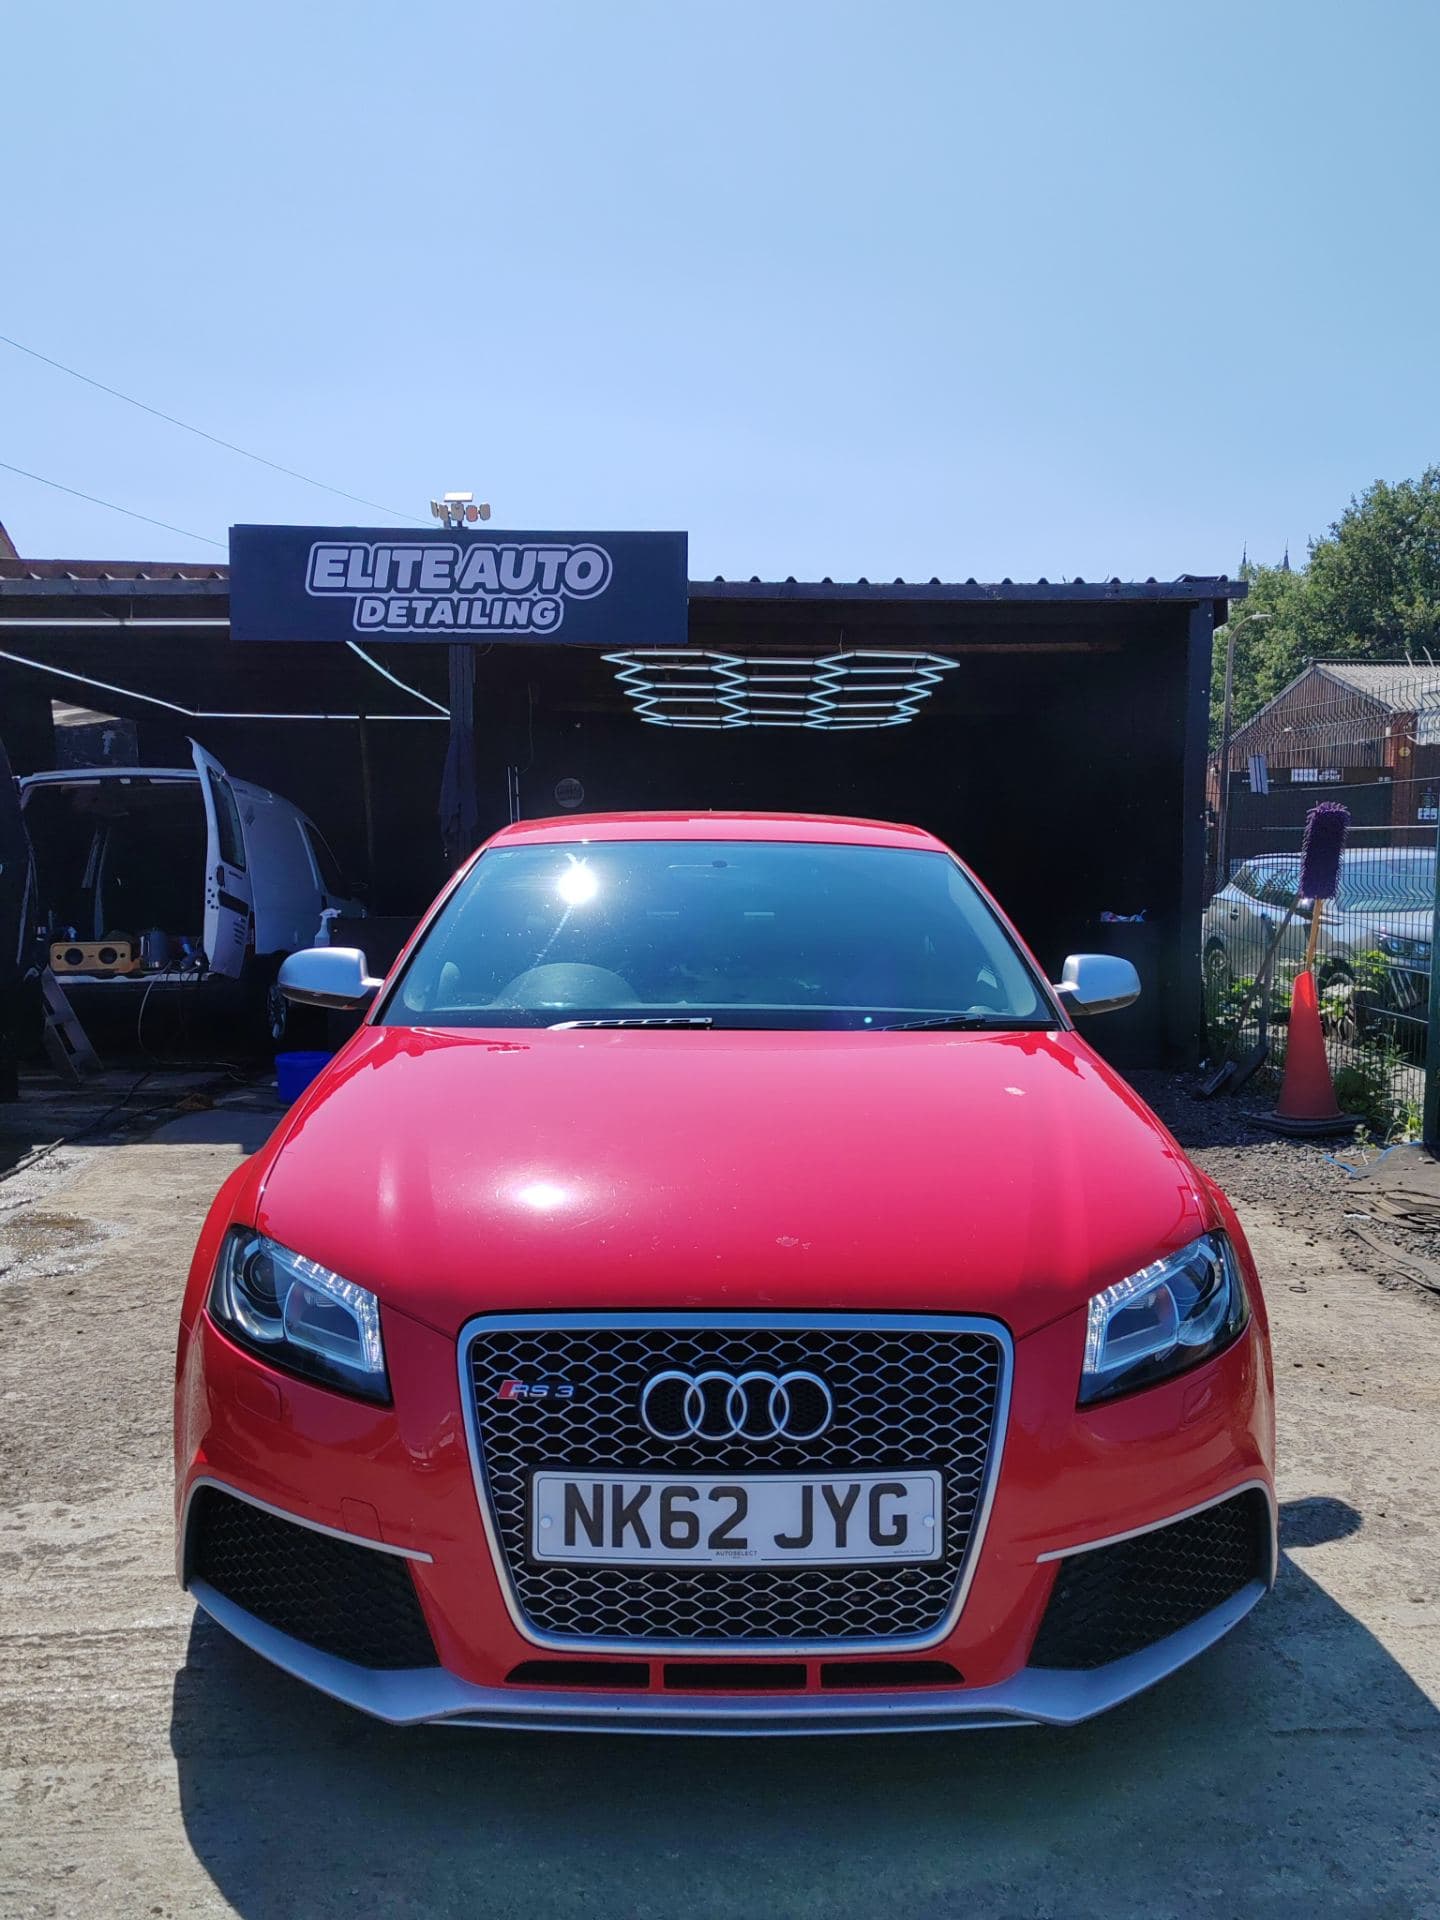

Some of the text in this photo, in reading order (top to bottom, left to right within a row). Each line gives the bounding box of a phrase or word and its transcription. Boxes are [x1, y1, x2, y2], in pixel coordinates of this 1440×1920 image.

[312, 548, 602, 591] ELITE AUTO
[359, 599, 557, 626] DETAILING
[509, 1383, 574, 1398] RS 3
[563, 1482, 908, 1550] NK62 JYG
